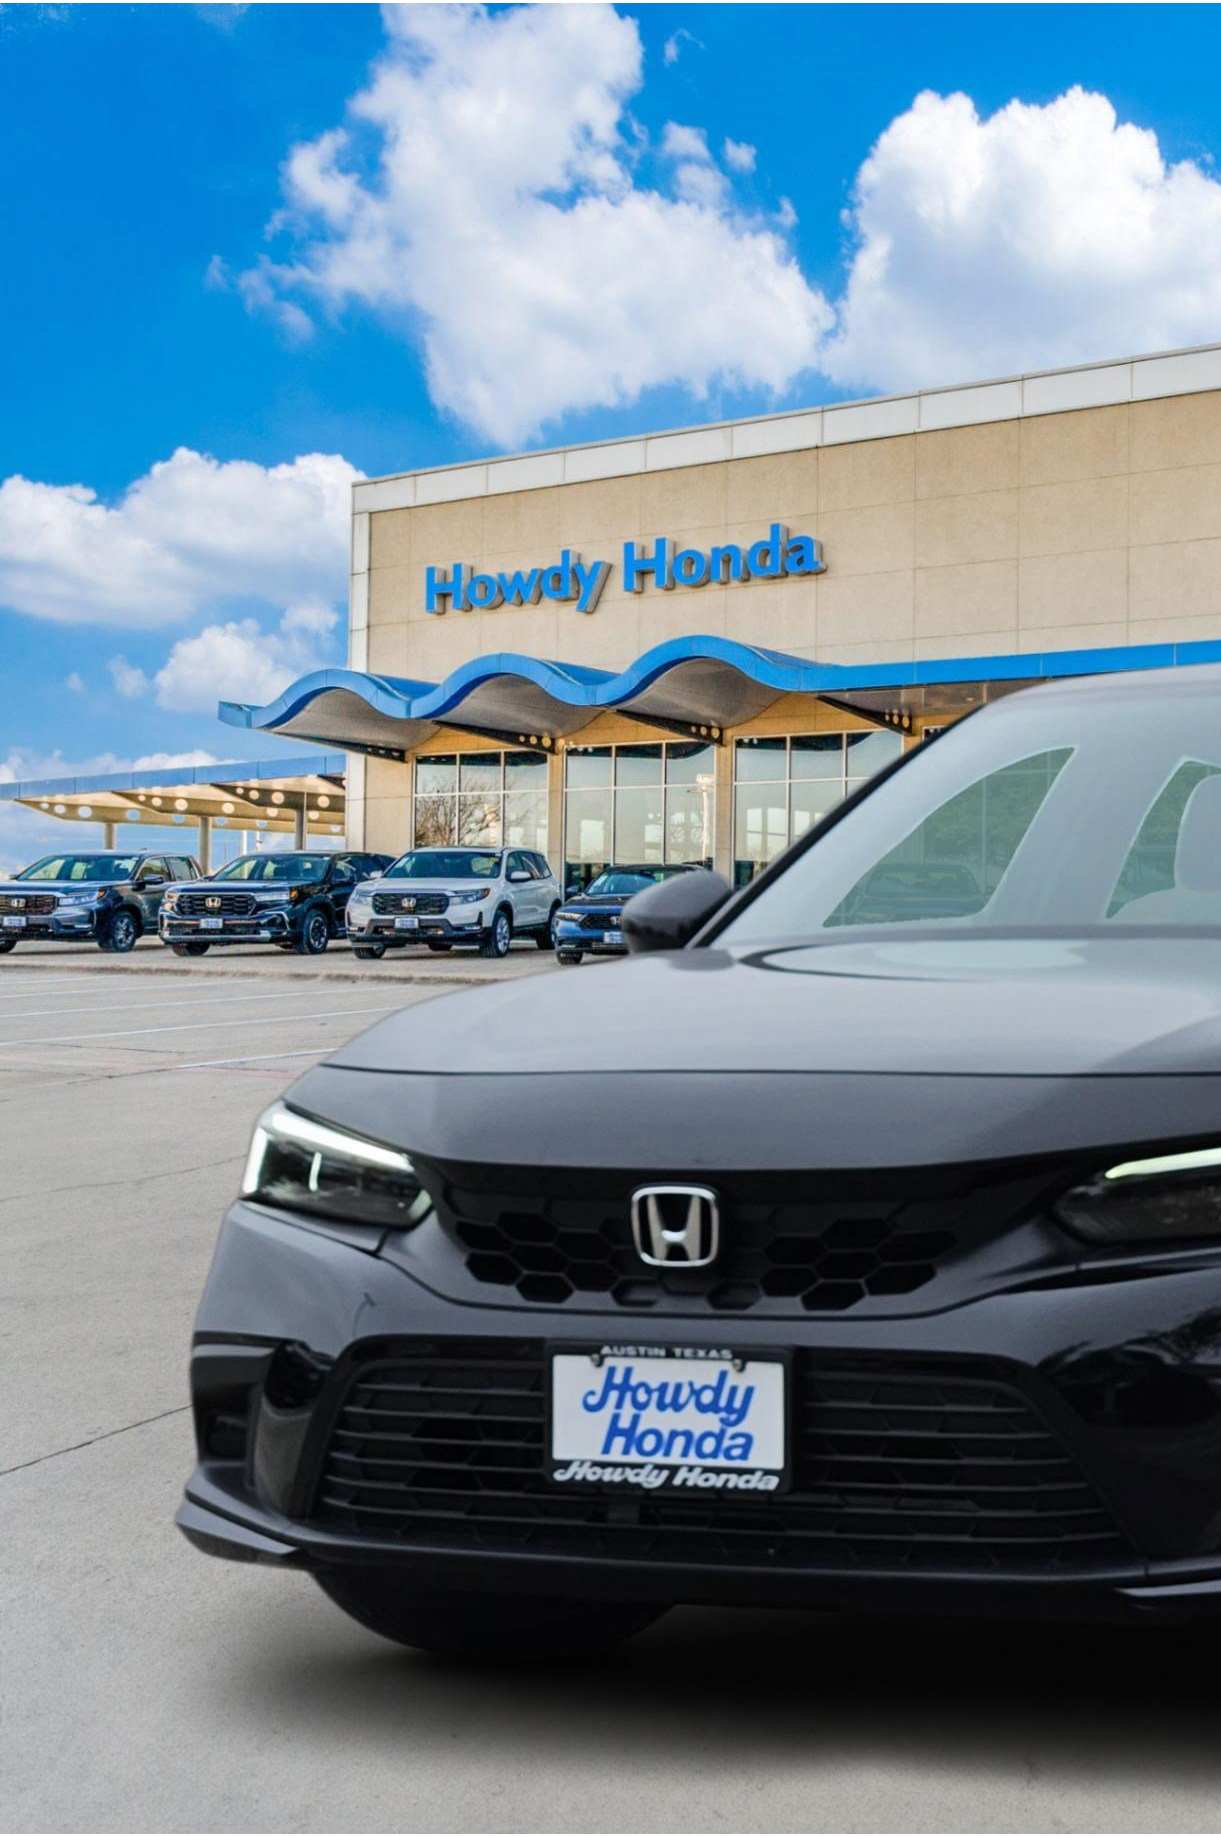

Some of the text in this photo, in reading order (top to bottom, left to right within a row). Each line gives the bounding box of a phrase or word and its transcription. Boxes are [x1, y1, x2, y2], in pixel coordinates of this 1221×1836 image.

[425, 523, 826, 614] Howdy Honda
[601, 1345, 733, 1360] AUSTIN TEXAS
[582, 1365, 755, 1427] Howdy
[601, 1412, 754, 1461] Honda
[553, 1460, 780, 1491] Howdy Honda
